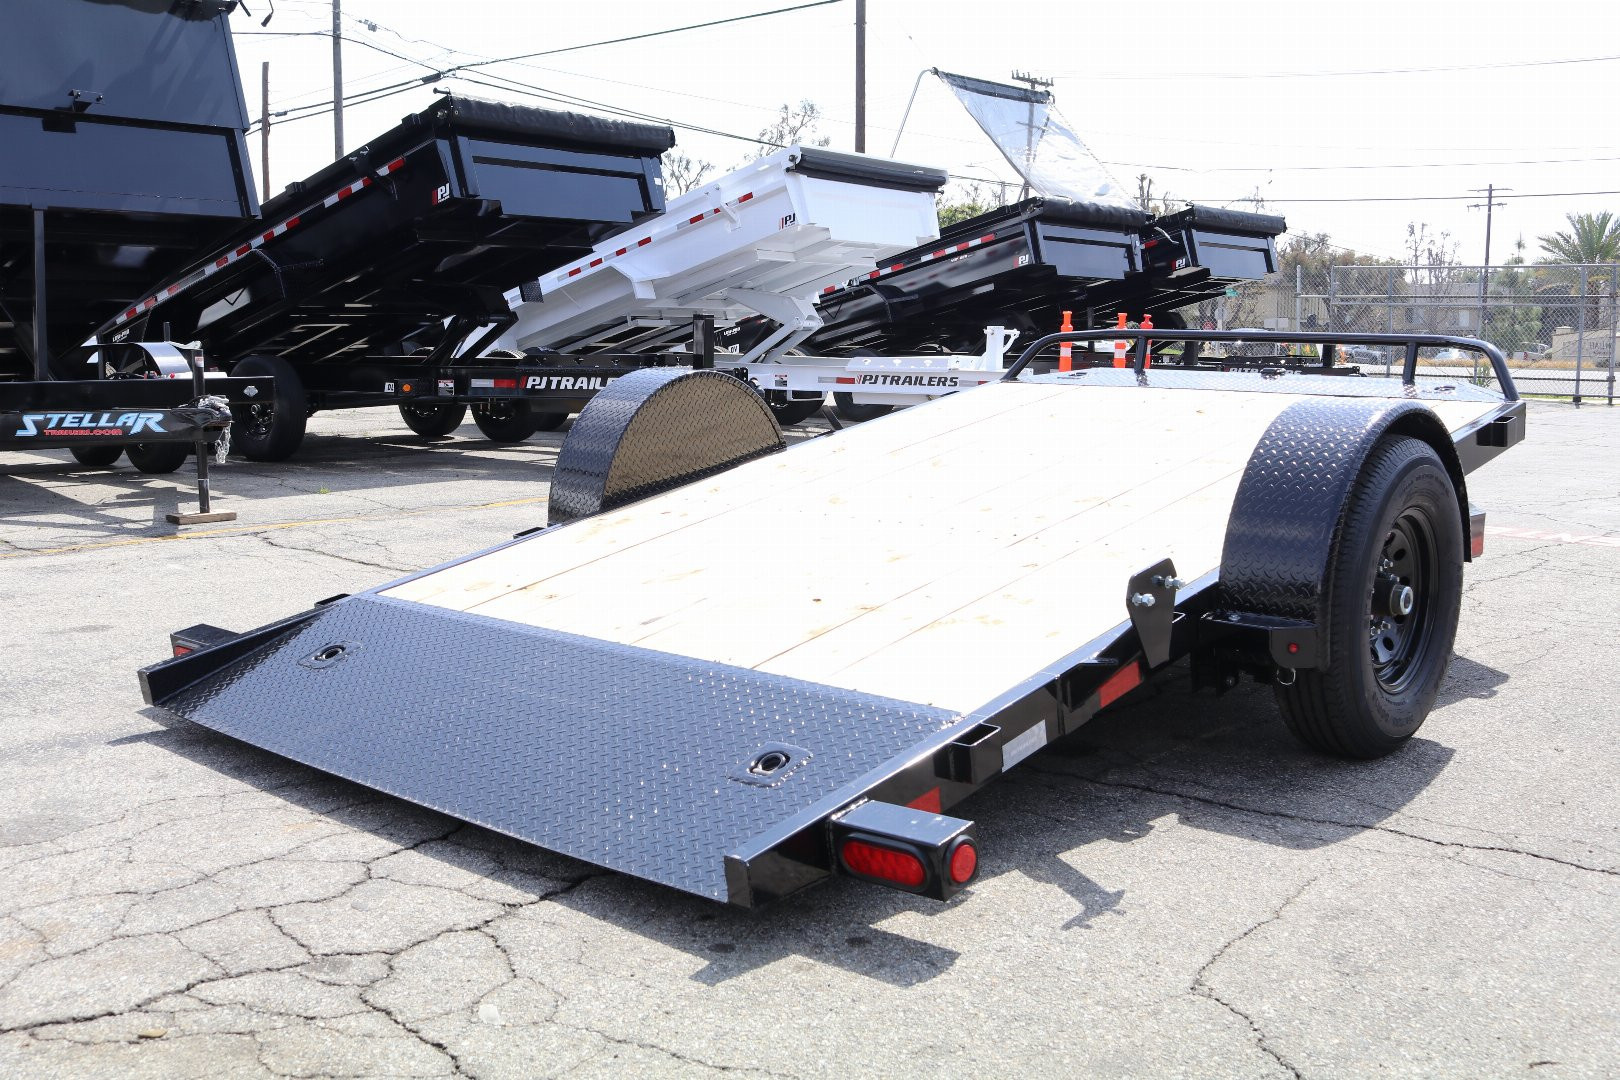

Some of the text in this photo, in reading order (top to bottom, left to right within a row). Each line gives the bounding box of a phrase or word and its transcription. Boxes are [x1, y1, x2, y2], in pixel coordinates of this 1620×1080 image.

[438, 183, 450, 200] PJ
[785, 213, 796, 225] PJ
[1018, 255, 1029, 265] PJ
[526, 376, 548, 389] PJ
[862, 375, 959, 387] PJ TRAILERS
[15, 412, 168, 436] STELLAR
